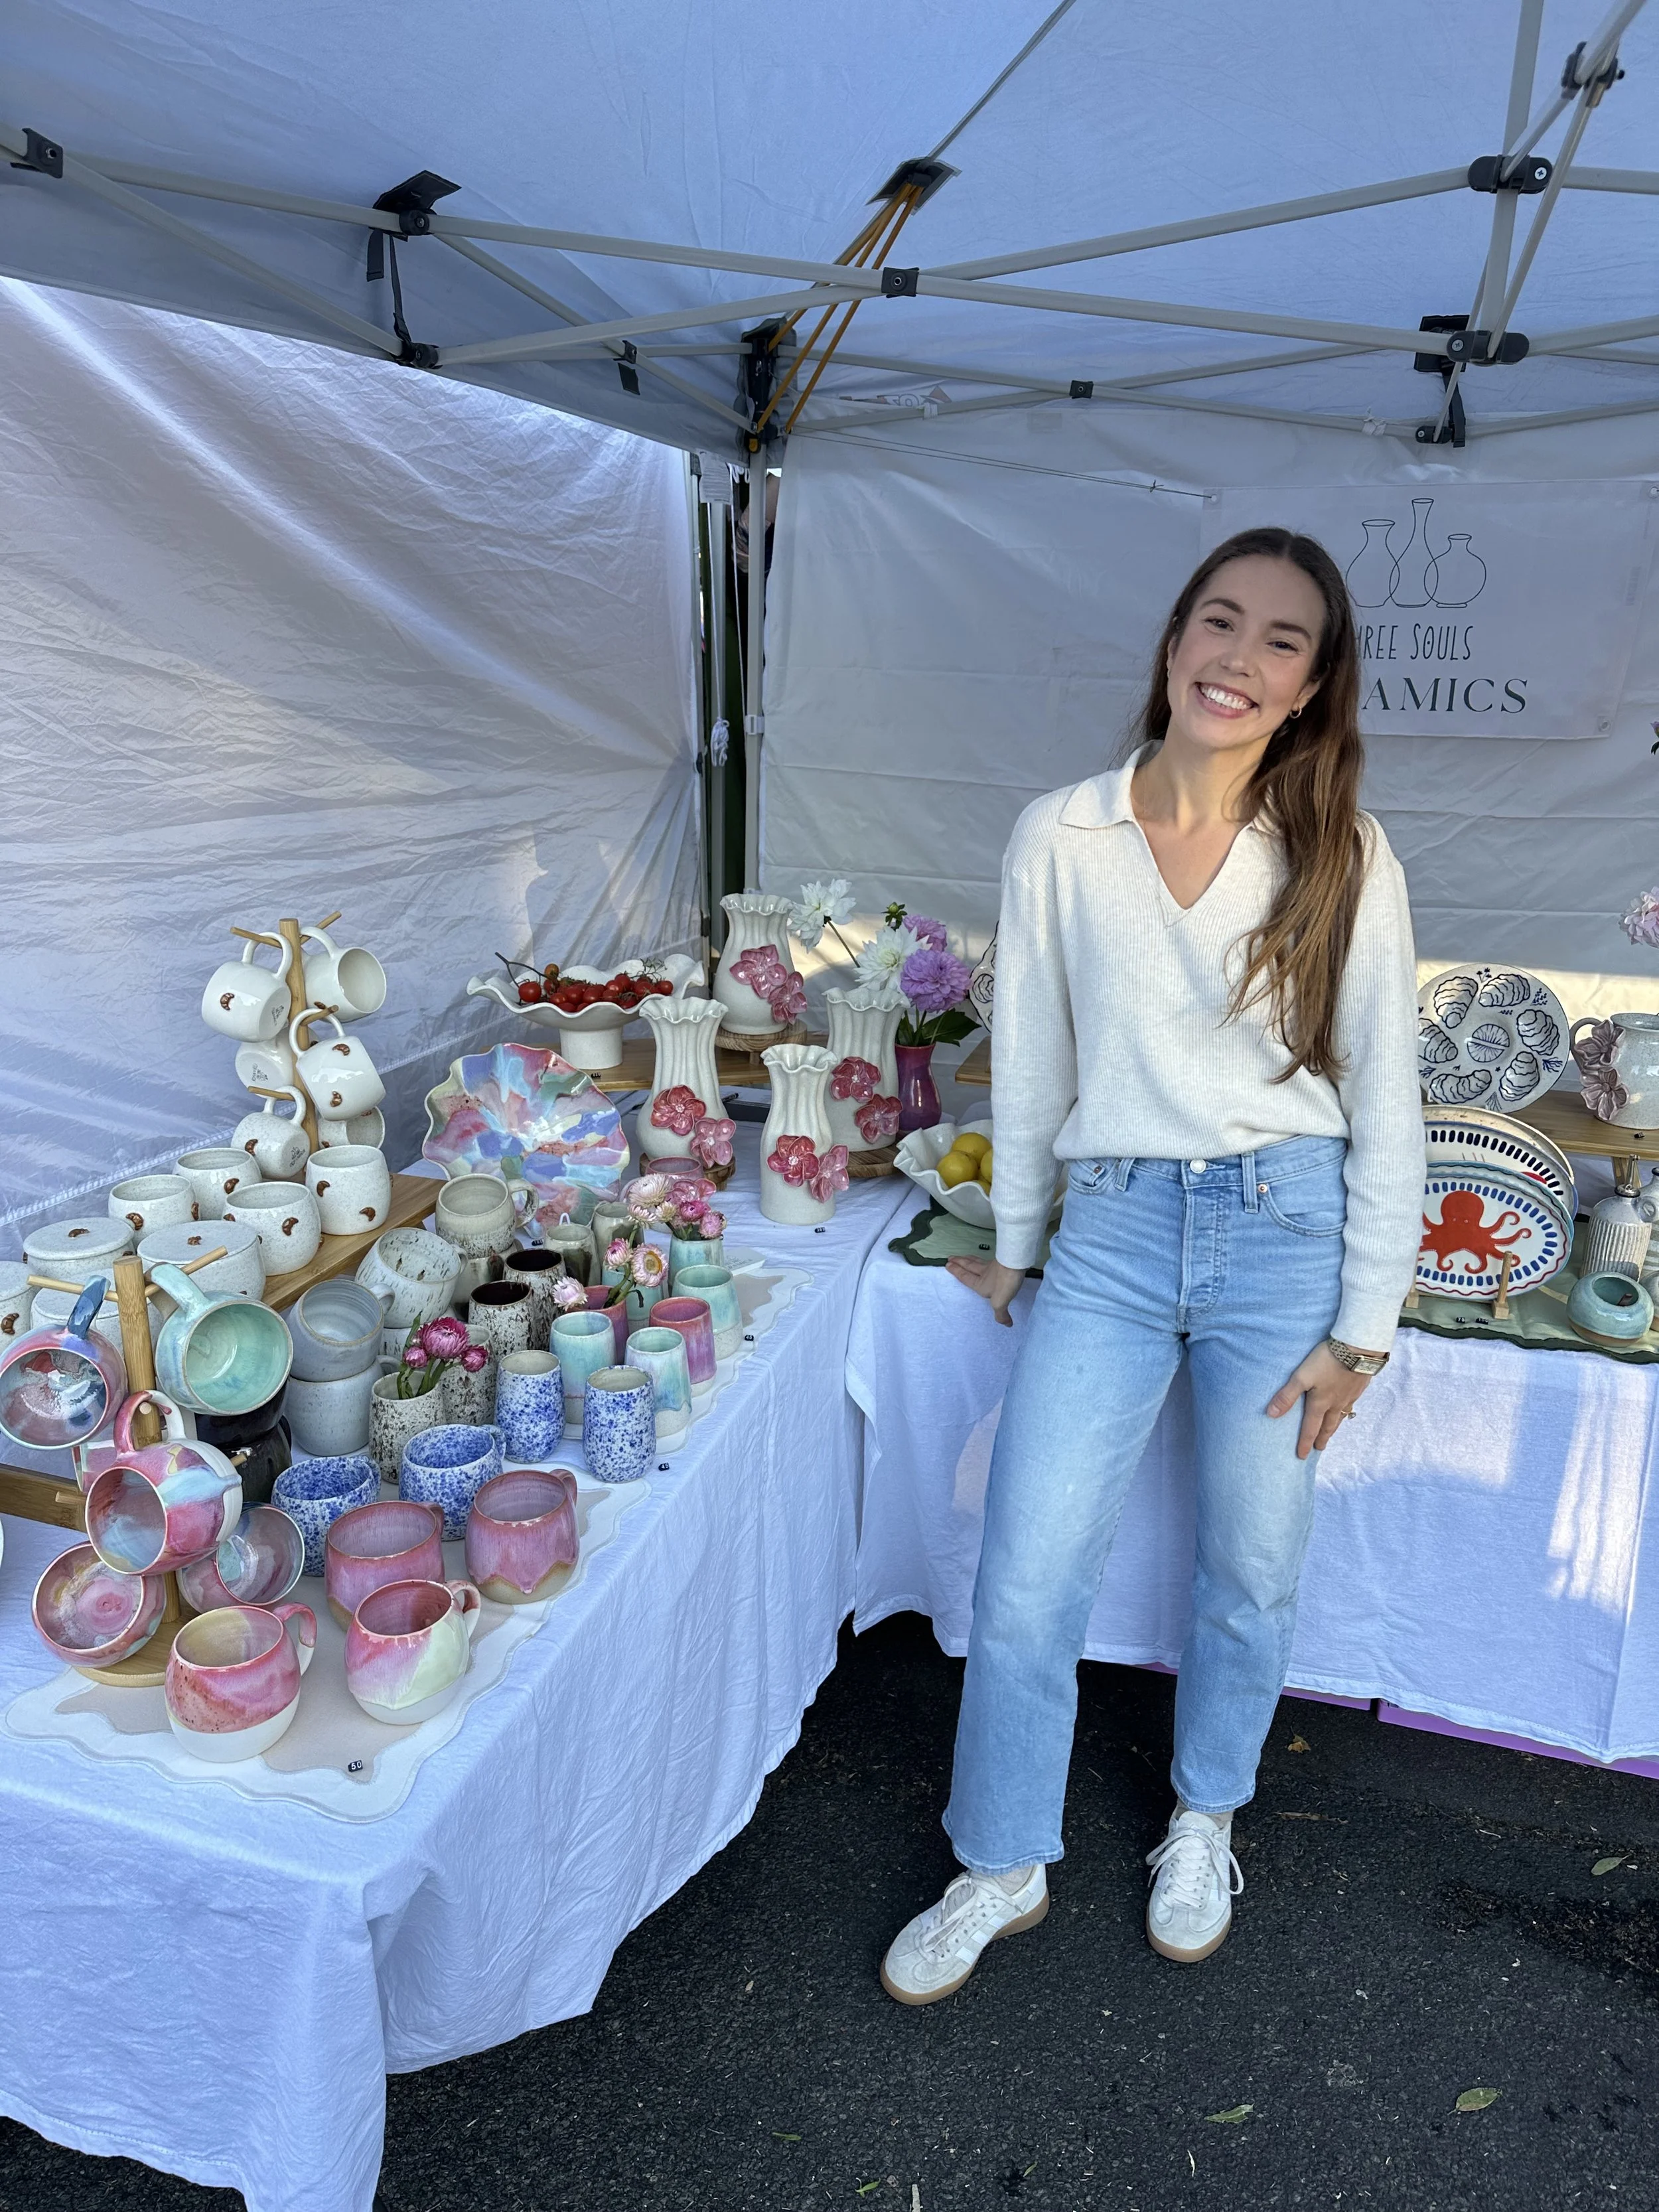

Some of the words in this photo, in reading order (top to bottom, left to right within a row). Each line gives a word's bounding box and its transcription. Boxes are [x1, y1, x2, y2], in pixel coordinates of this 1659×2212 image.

[1355, 625, 1399, 660] HREE
[1409, 623, 1474, 661] SOULS
[1361, 677, 1528, 714] AMICS
[350, 1760, 362, 1771] 50
